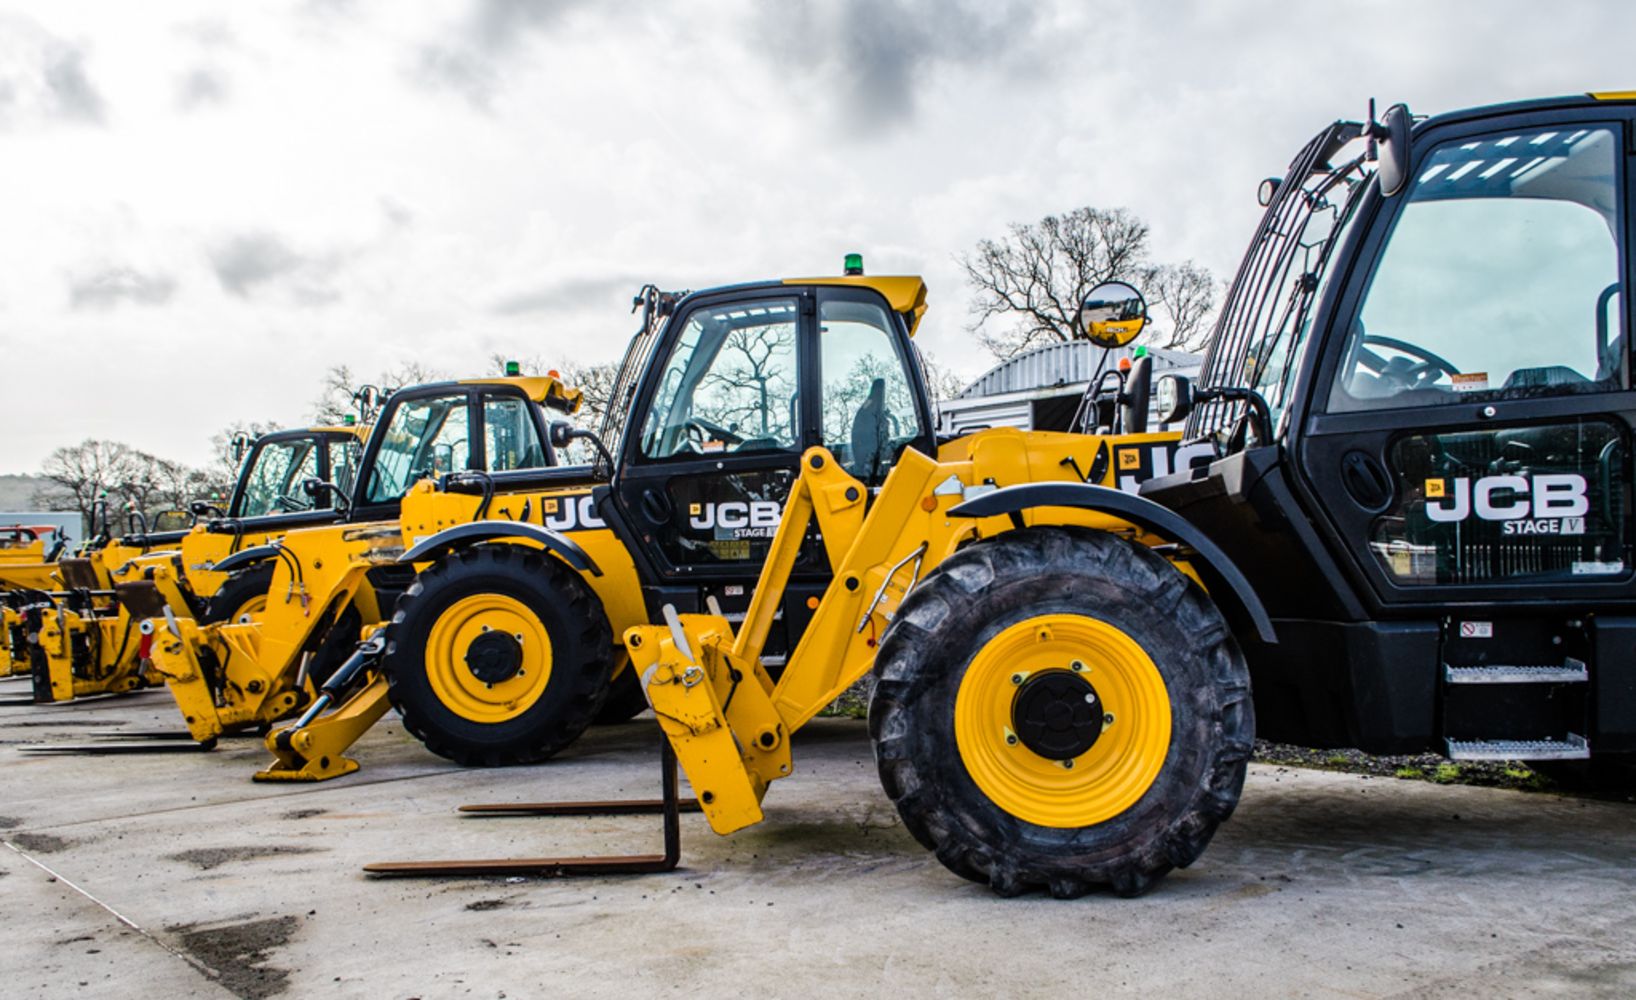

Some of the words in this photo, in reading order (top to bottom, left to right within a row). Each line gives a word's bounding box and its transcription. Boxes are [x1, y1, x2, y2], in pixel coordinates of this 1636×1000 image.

[1425, 474, 1589, 521] JCB
[545, 496, 606, 530] JC
[690, 502, 782, 529] JCB
[1503, 519, 1559, 534] STAGE
[734, 528, 765, 538] STAGE
